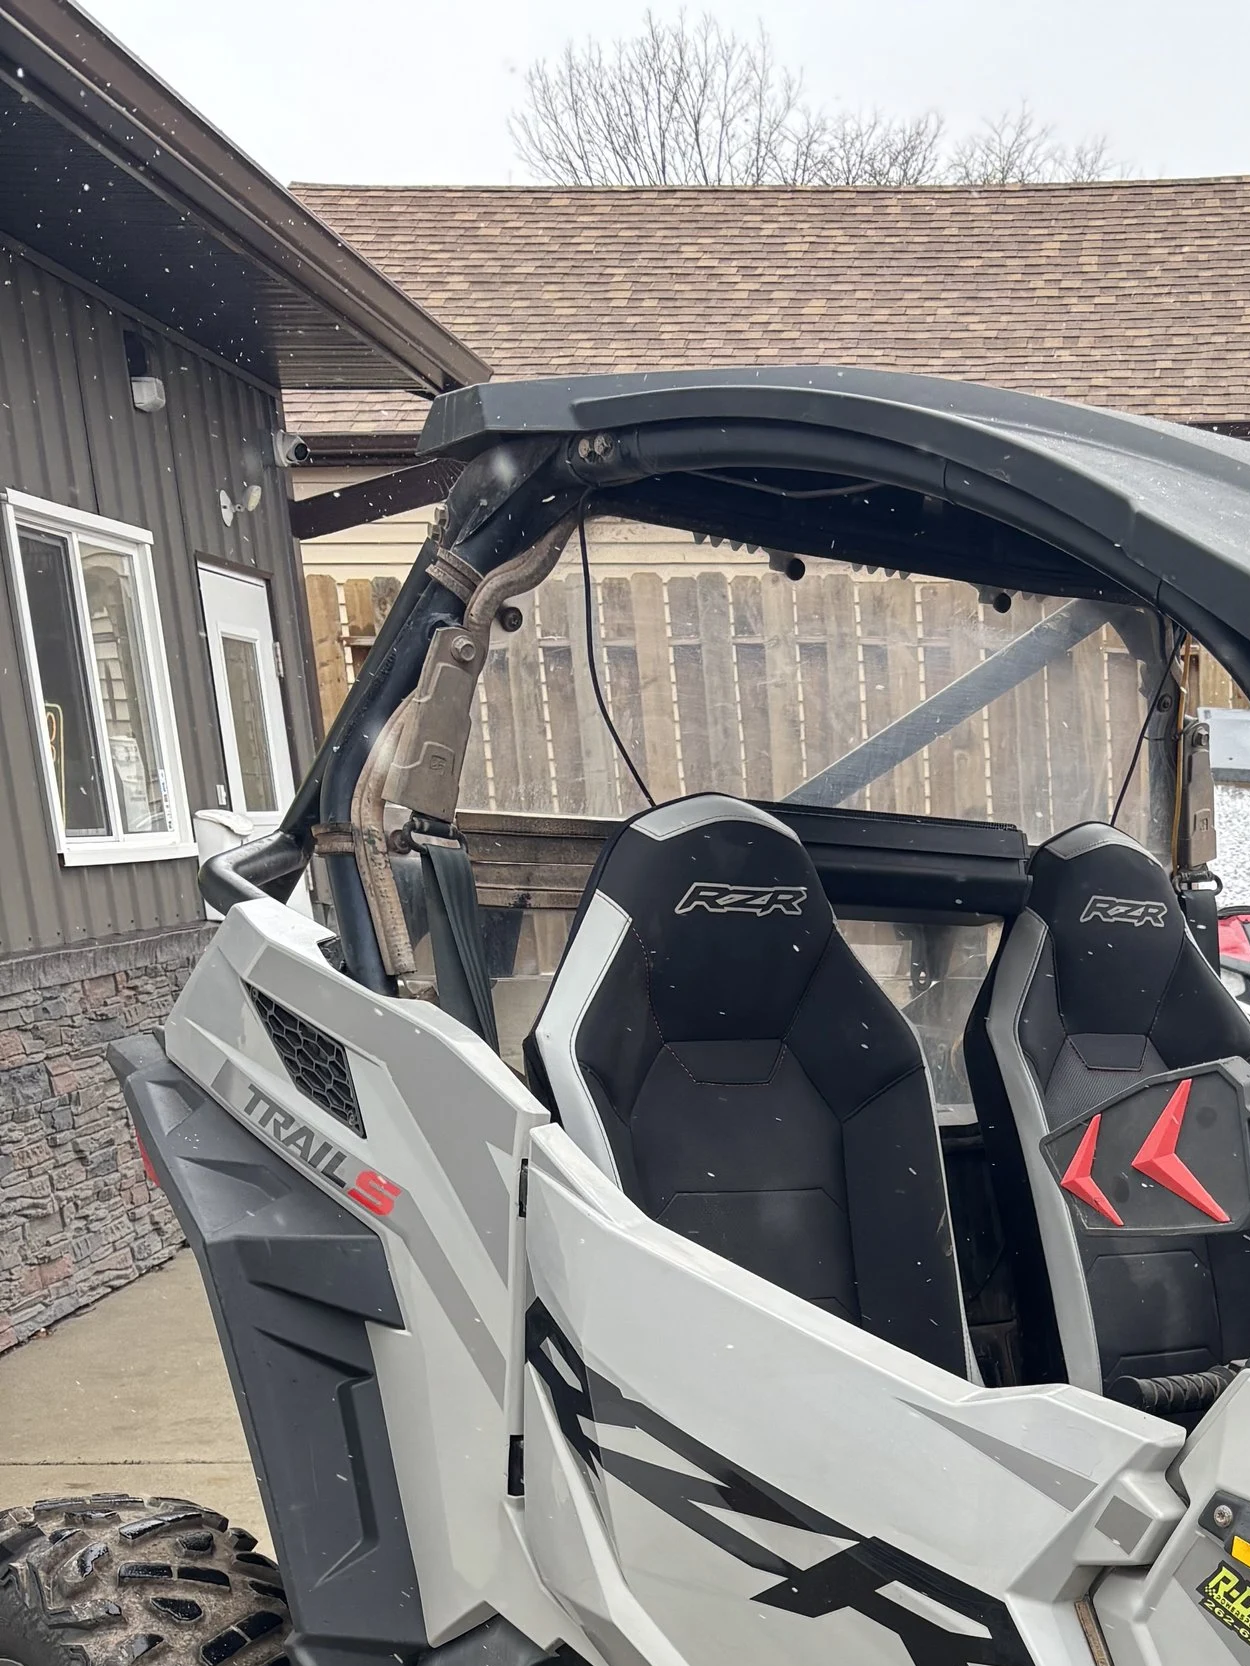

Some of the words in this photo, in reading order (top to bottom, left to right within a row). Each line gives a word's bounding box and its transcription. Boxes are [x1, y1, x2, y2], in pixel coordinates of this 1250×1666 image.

[674, 881, 808, 917] RZR
[1079, 895, 1169, 929] RZR
[243, 1083, 348, 1189] TRAIL
[347, 1169, 402, 1216] S
